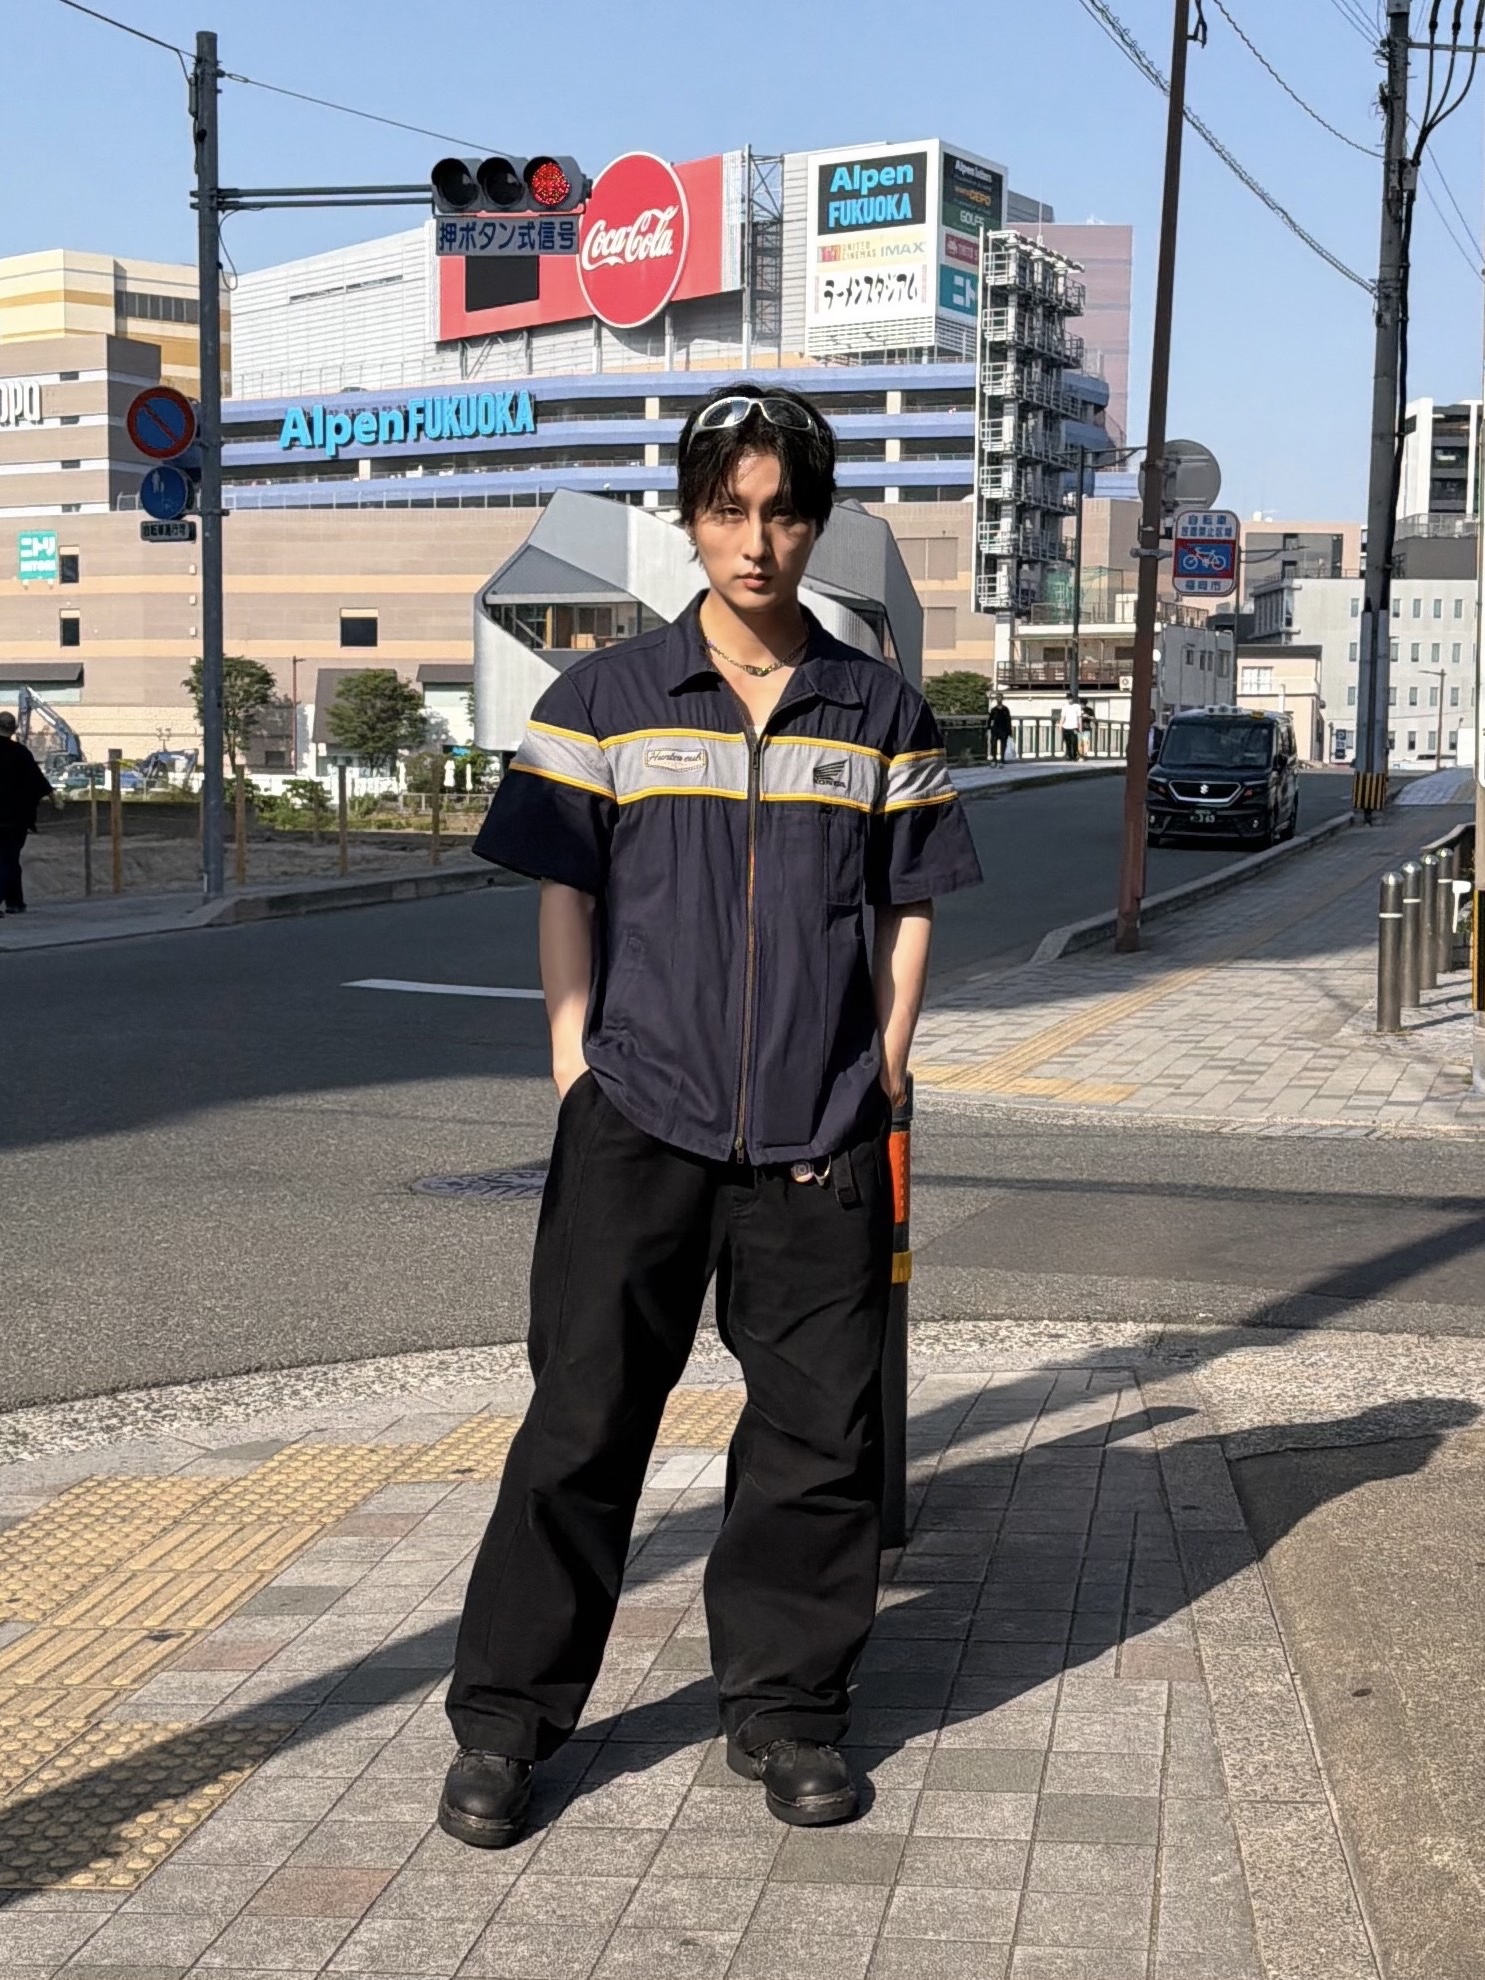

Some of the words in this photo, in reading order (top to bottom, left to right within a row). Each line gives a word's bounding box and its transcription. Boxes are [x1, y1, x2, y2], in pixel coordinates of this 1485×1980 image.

[830, 163, 914, 196] Alpen
[828, 192, 912, 229] FUKUOKA
[439, 220, 577, 251] 押ボタン式信号
[881, 242, 925, 257] IMAX
[823, 272, 918, 310] ラーメンスタジアム
[279, 404, 405, 457] Alpen
[408, 389, 536, 440] FUKUOKA
[20, 536, 56, 558] ニトリ
